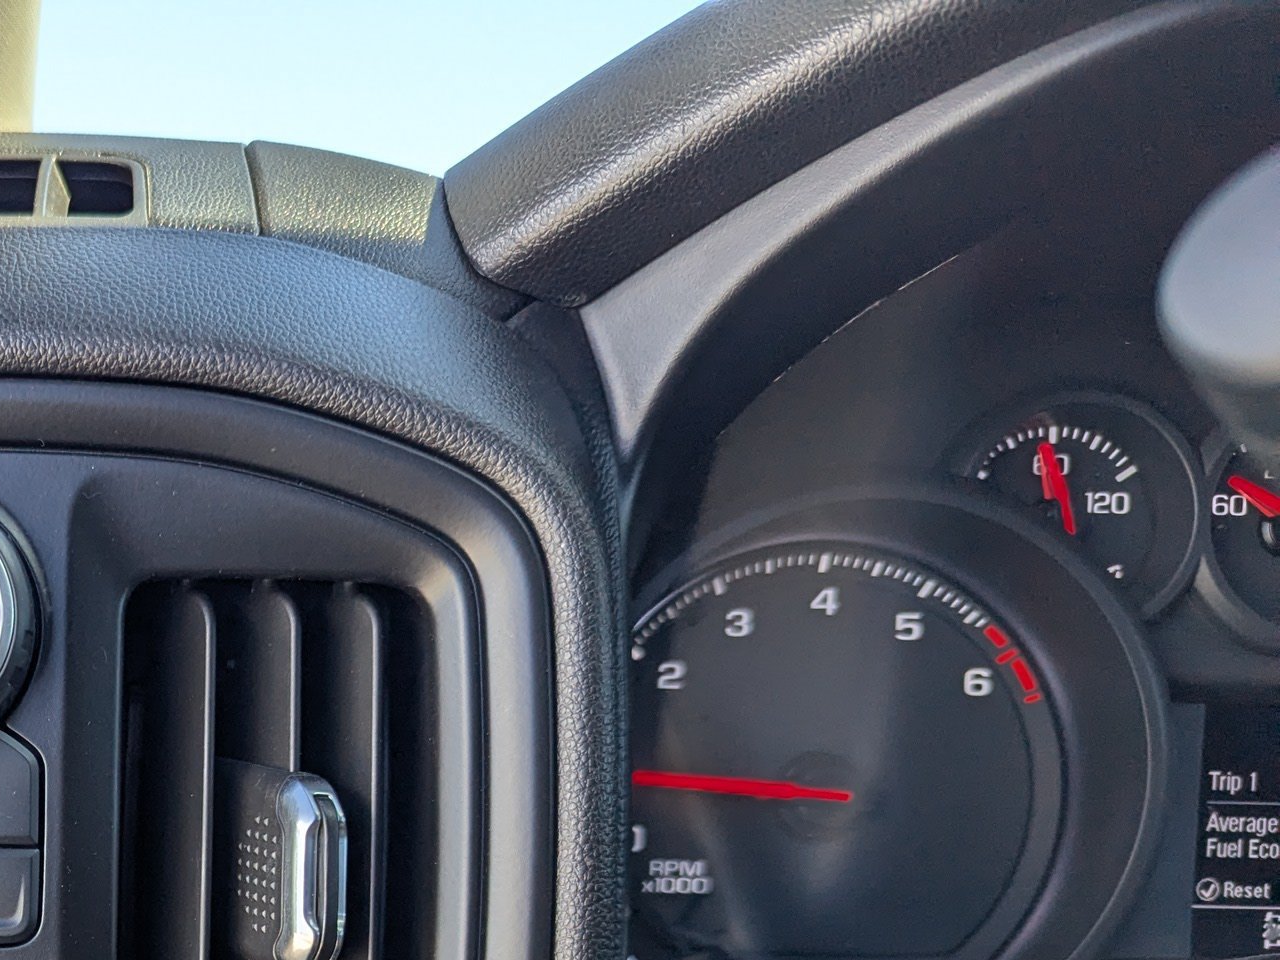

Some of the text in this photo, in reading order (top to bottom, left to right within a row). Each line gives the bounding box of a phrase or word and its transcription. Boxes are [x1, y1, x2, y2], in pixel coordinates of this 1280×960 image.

[1084, 491, 1131, 515] 120
[1212, 495, 1247, 517] 60
[810, 586, 839, 616] 4
[724, 607, 755, 638] 3
[894, 611, 924, 641] 5
[656, 659, 686, 690] 2
[963, 667, 993, 696] 6
[1208, 771, 1257, 795] Trip 1
[1206, 811, 1279, 836] Average
[1206, 837, 1280, 859] Fuel Eco
[648, 860, 707, 876] RPM
[641, 877, 715, 894] x1000
[1223, 882, 1270, 899] Reset
